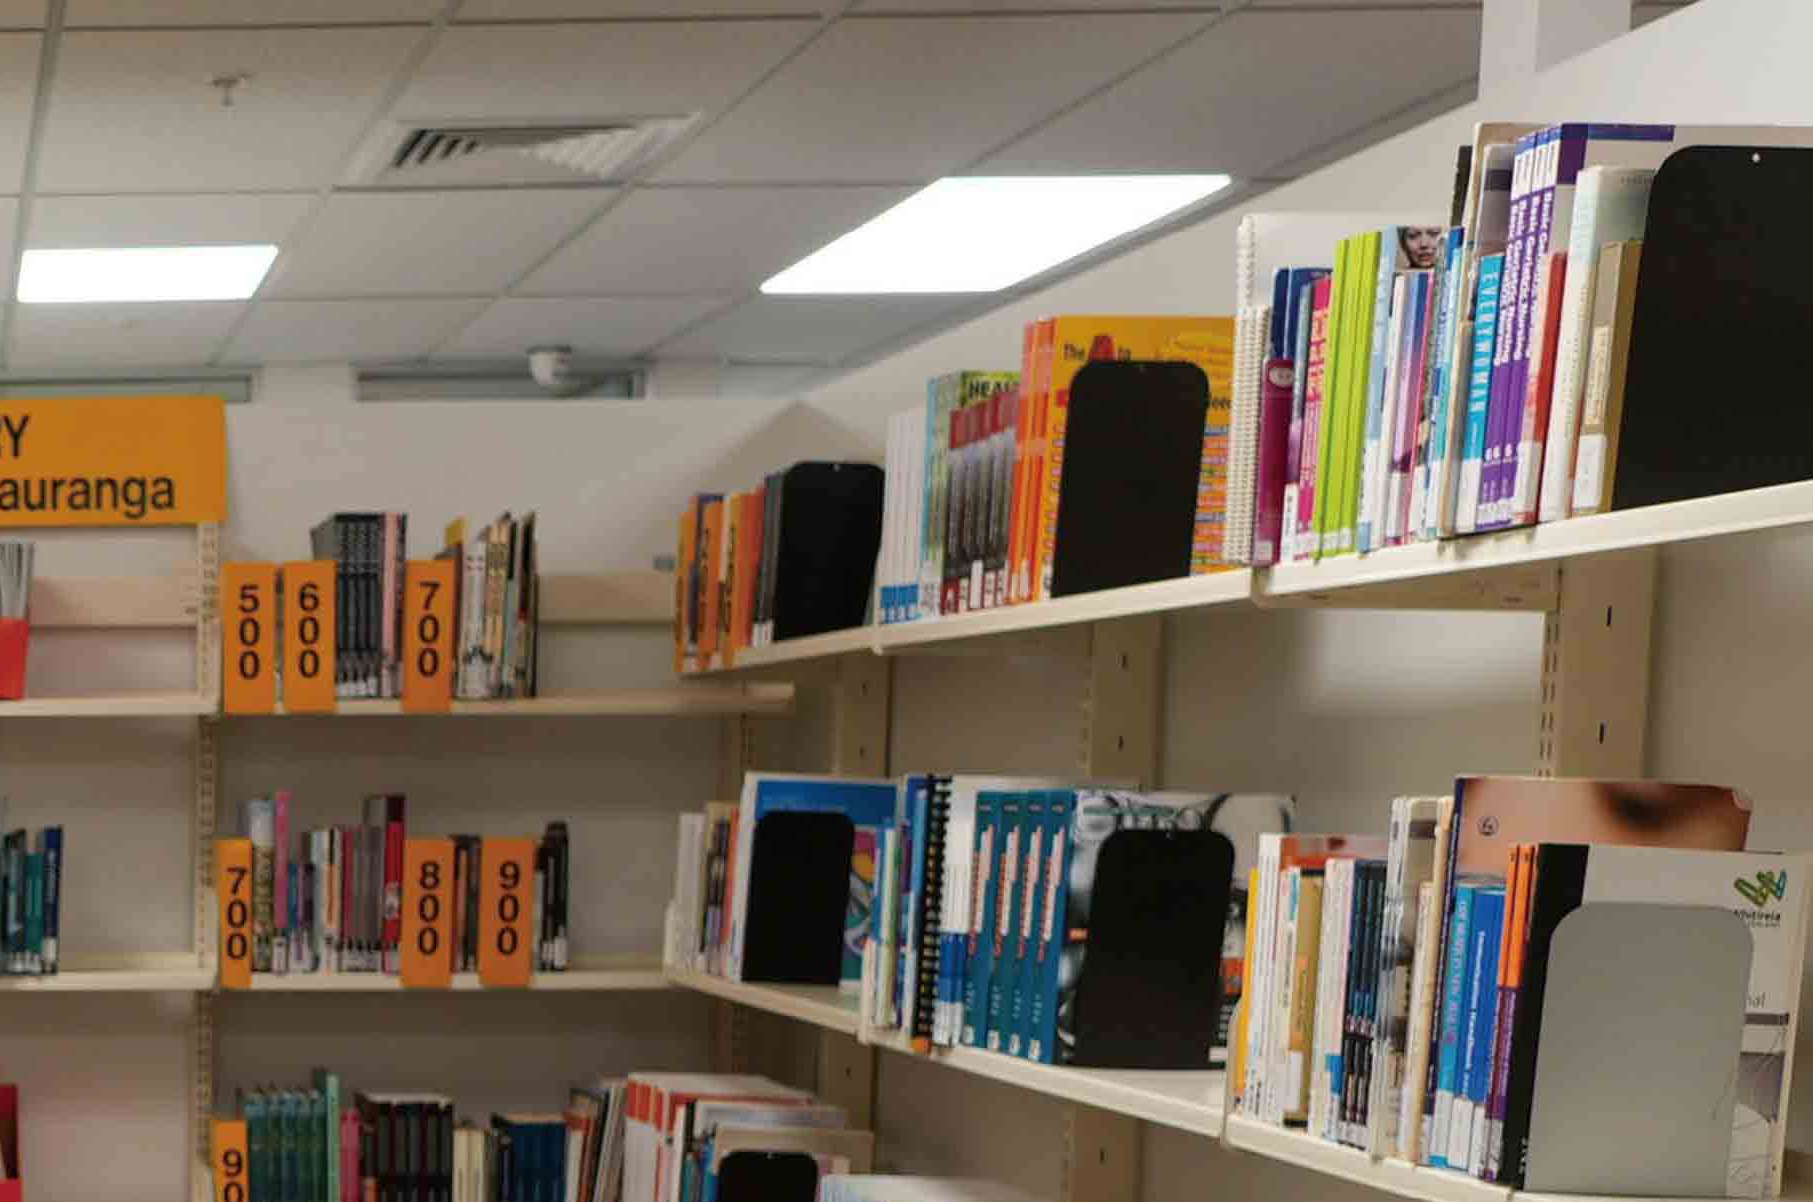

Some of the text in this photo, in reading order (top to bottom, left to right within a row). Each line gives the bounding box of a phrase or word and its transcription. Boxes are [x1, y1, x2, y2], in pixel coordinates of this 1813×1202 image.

[238, 583, 261, 680] 500
[298, 581, 321, 679] 600
[417, 581, 441, 677] 700
[228, 867, 248, 960] 700
[419, 861, 440, 955] 800
[498, 861, 520, 955] 900
